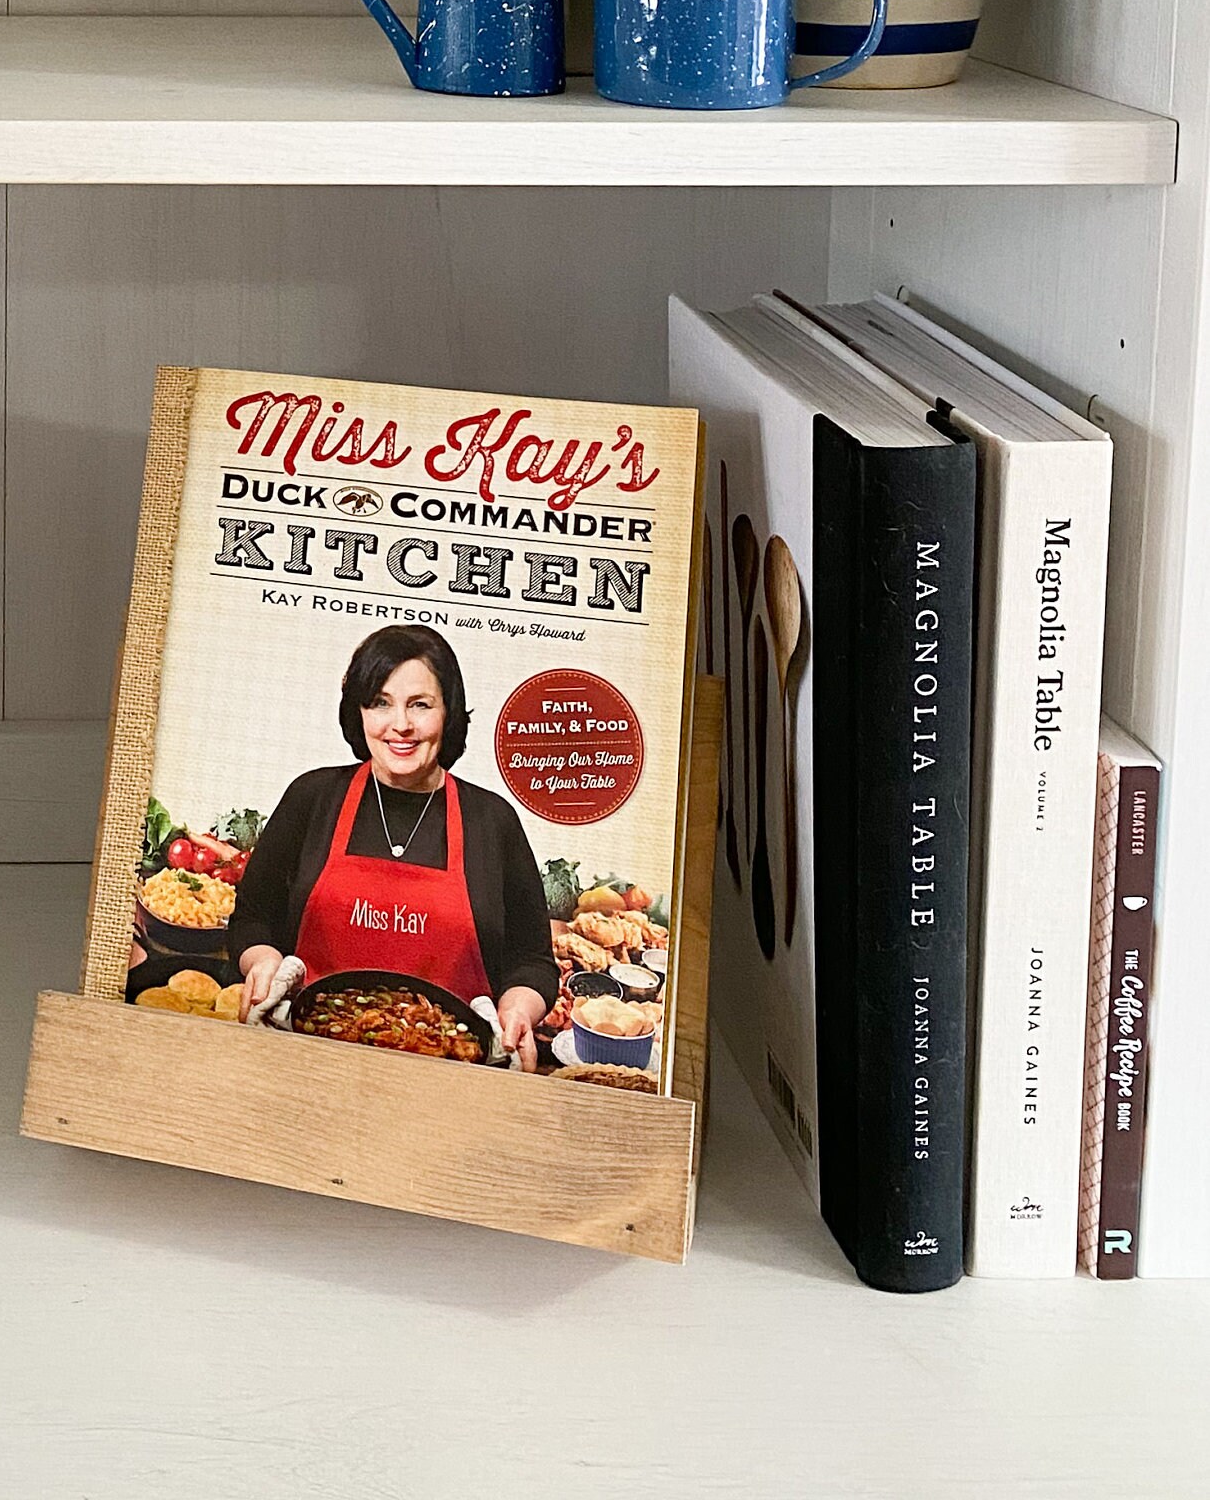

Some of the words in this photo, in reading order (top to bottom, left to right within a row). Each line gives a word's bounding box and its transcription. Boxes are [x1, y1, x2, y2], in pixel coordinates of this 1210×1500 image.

[226, 390, 412, 476] Miss
[424, 408, 660, 511] Kay's
[215, 518, 651, 613] KITCHEN
[1035, 518, 1072, 661] Magnolia
[455, 617, 483, 629] with
[488, 618, 526, 637] Chrys
[529, 623, 586, 641] Howard
[913, 541, 940, 773] MAGNOLIA
[569, 720, 582, 733] &
[1033, 669, 1064, 752] Table
[509, 752, 566, 771] Bringing
[568, 751, 593, 767] Our
[595, 751, 634, 766] Home
[530, 777, 544, 790] to
[545, 775, 579, 794] Your
[580, 773, 616, 789] Table
[1036, 771, 1046, 820] VOLUME
[1131, 790, 1147, 855] LANCASTER
[911, 797, 936, 927] TABLE
[350, 898, 389, 931] Miss
[393, 903, 428, 935] Kay
[1027, 948, 1044, 1032] JOANNA
[1124, 949, 1139, 970] THE
[912, 976, 930, 1065] JOANNA
[1113, 975, 1145, 1036] Coffee
[1024, 1046, 1039, 1125] GAINES
[1110, 1038, 1143, 1097] Recipe
[914, 1077, 929, 1160] GAINES
[1117, 1102, 1132, 1131] BOOK
